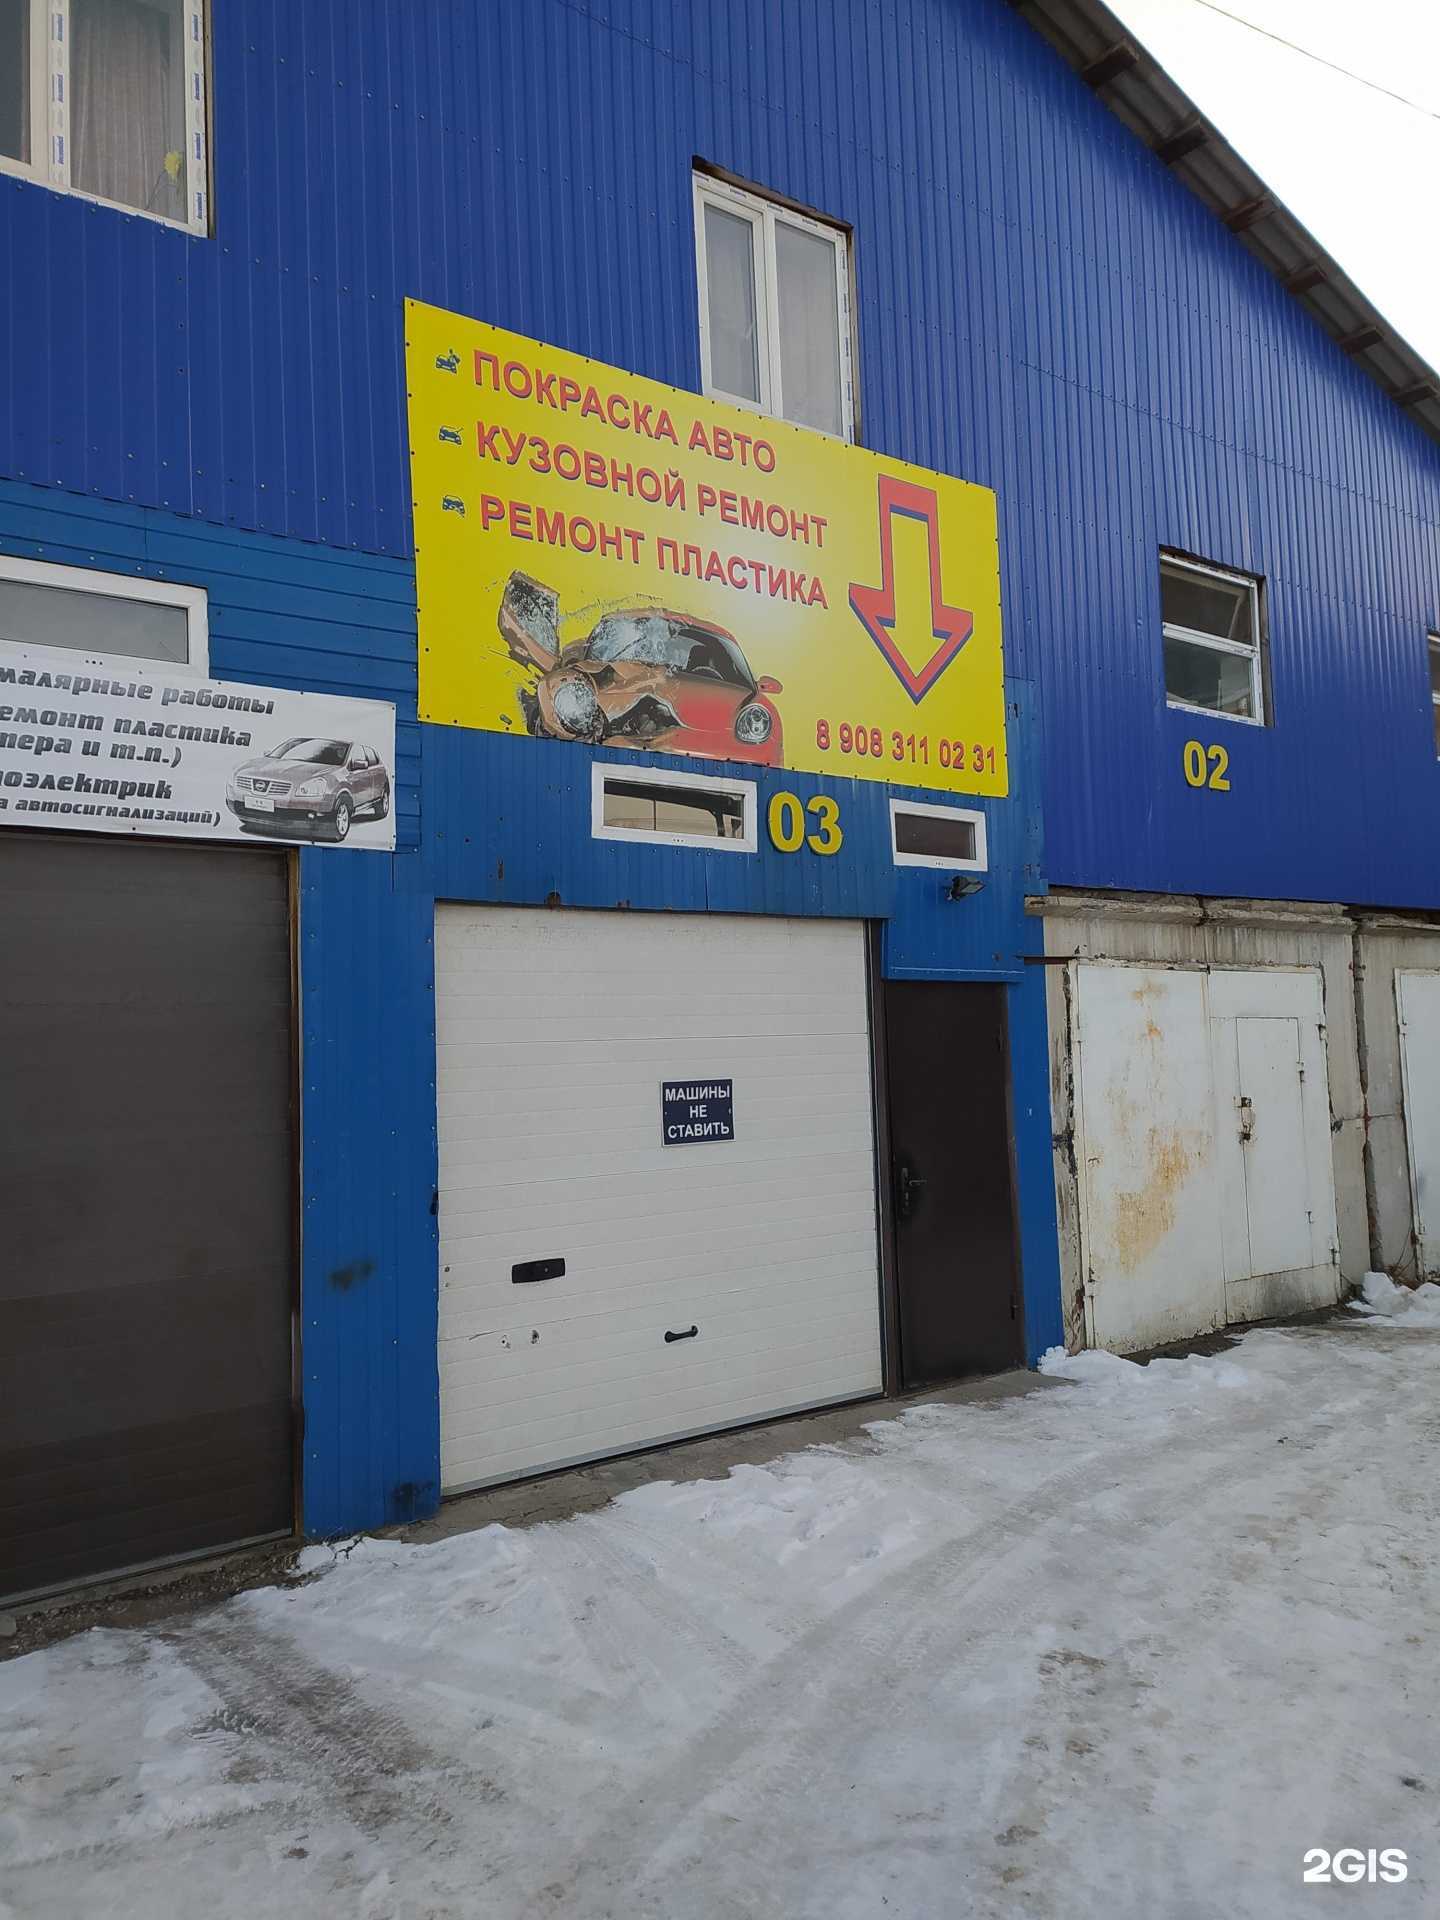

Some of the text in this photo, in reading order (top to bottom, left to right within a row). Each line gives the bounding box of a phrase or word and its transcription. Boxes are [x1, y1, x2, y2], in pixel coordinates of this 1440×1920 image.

[473, 349, 776, 473] ПОКРАСКА АВТО
[476, 421, 828, 548] КУЗОВНОЙ РЕМОНТ
[480, 493, 829, 610] РЕМОНТ ПЛАСТИКА
[161, 687, 275, 715] работы
[113, 718, 252, 747] пластика
[816, 719, 996, 774] 8 908 311 02 31
[81, 740, 101, 757] и
[1183, 740, 1231, 792] 02
[0, 770, 173, 800] оэлектрик
[15, 799, 221, 827] автосигнализаций)
[767, 790, 844, 857] 03
[665, 1085, 730, 1102] МАШИНЫ
[689, 1104, 708, 1119] НЕ
[667, 1121, 730, 1139] СТАВИТЬ
